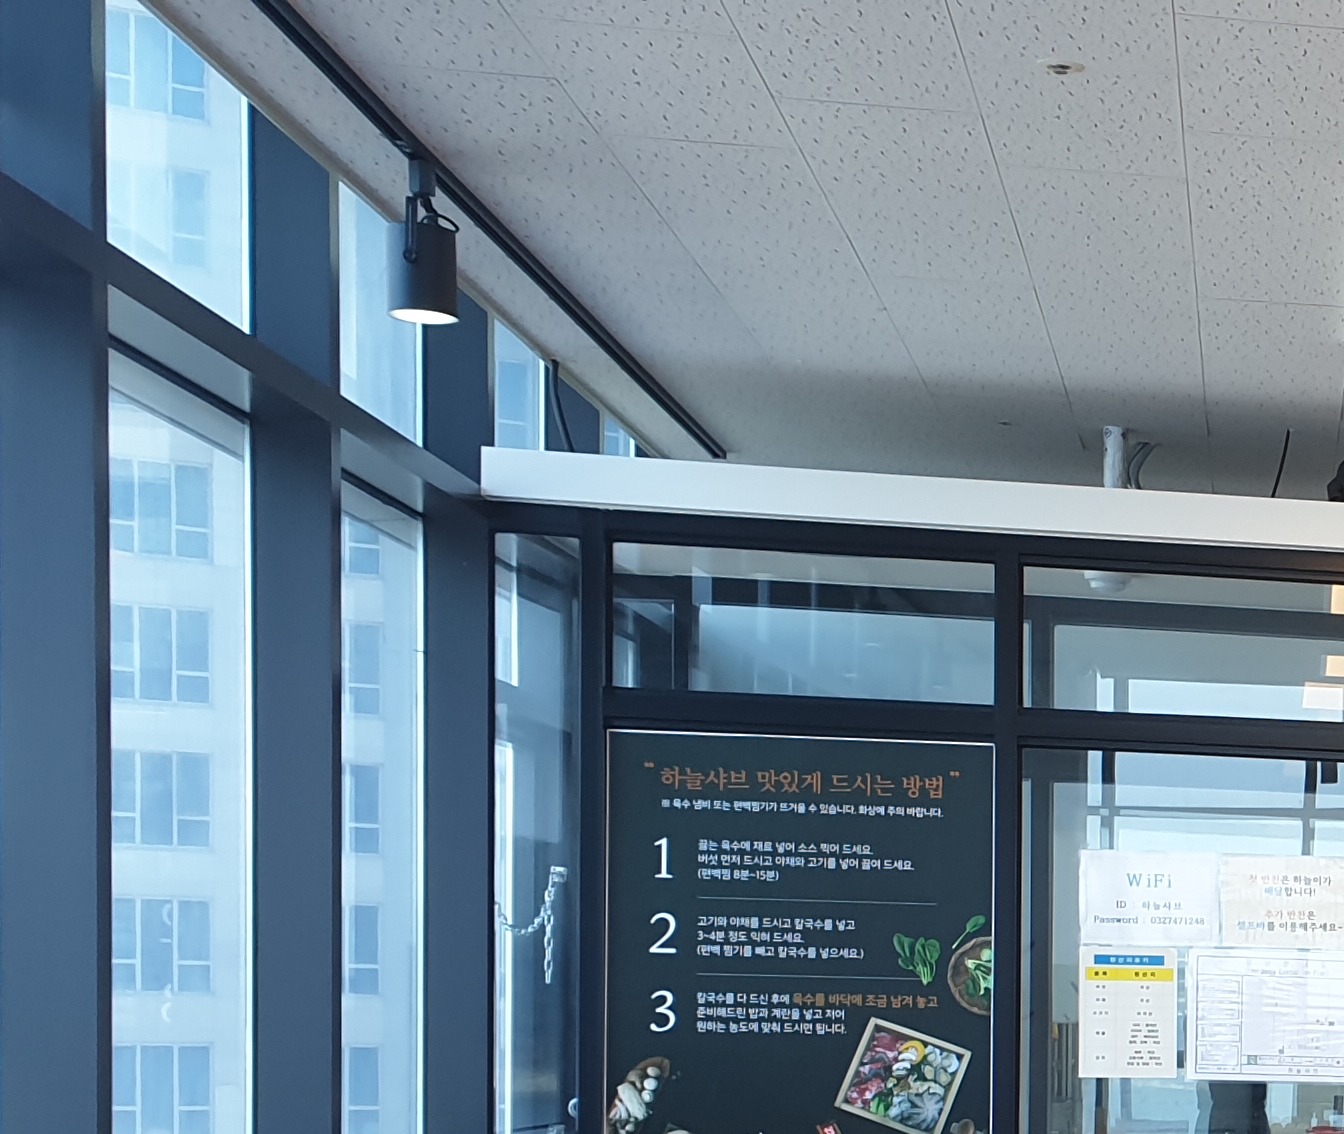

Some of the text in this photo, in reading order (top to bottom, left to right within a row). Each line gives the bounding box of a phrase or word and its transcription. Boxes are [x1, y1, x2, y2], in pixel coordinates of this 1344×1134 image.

[661, 766, 944, 799] 하늘샤브 맛있게 드시는 방법
[713, 800, 731, 811] 또는
[780, 802, 806, 814] 뜨거울
[808, 803, 817, 813] 수
[858, 804, 885, 816] 화상에
[887, 806, 905, 817] 주의
[797, 842, 817, 853] 소스
[653, 836, 674, 879] 1
[697, 853, 718, 866] 버섯
[720, 854, 740, 866] 먼저
[743, 855, 773, 867] 드시고
[775, 856, 805, 868] 야채와
[807, 857, 836, 869] 고기를
[733, 869, 779, 882] 8분~15분)
[1126, 873, 1172, 888] WiFi
[1261, 875, 1290, 886] 반찬은
[1294, 875, 1331, 887] 하늘이가
[1264, 887, 1316, 898] 배달합니다!
[1116, 900, 1127, 909] ID
[1094, 915, 1138, 924] Password
[1265, 910, 1316, 921] 추가 반찬은
[697, 916, 856, 931] 고기와 야채를 드시고 칼국수를 넣고
[648, 911, 677, 954] 2
[697, 930, 725, 942] 3~4분
[728, 931, 748, 942] 정도
[777, 946, 817, 959] 칼국수를
[697, 992, 734, 1005] 칼국수를
[737, 993, 747, 1004] 다
[749, 993, 769, 1005] 드신
[771, 994, 790, 1005] 후에
[828, 993, 863, 1007] 바닥에
[865, 994, 887, 1008] 조금
[890, 995, 913, 1008] 남겨
[649, 989, 676, 1033] 3
[748, 1007, 768, 1019] 밥과
[770, 1008, 800, 1020] 계란을
[803, 1009, 823, 1020] 넣고
[825, 1009, 845, 1021] 저어
[697, 1020, 726, 1033] 원하는
[729, 1021, 759, 1033] 농도에
[783, 1022, 813, 1034] 드시면
